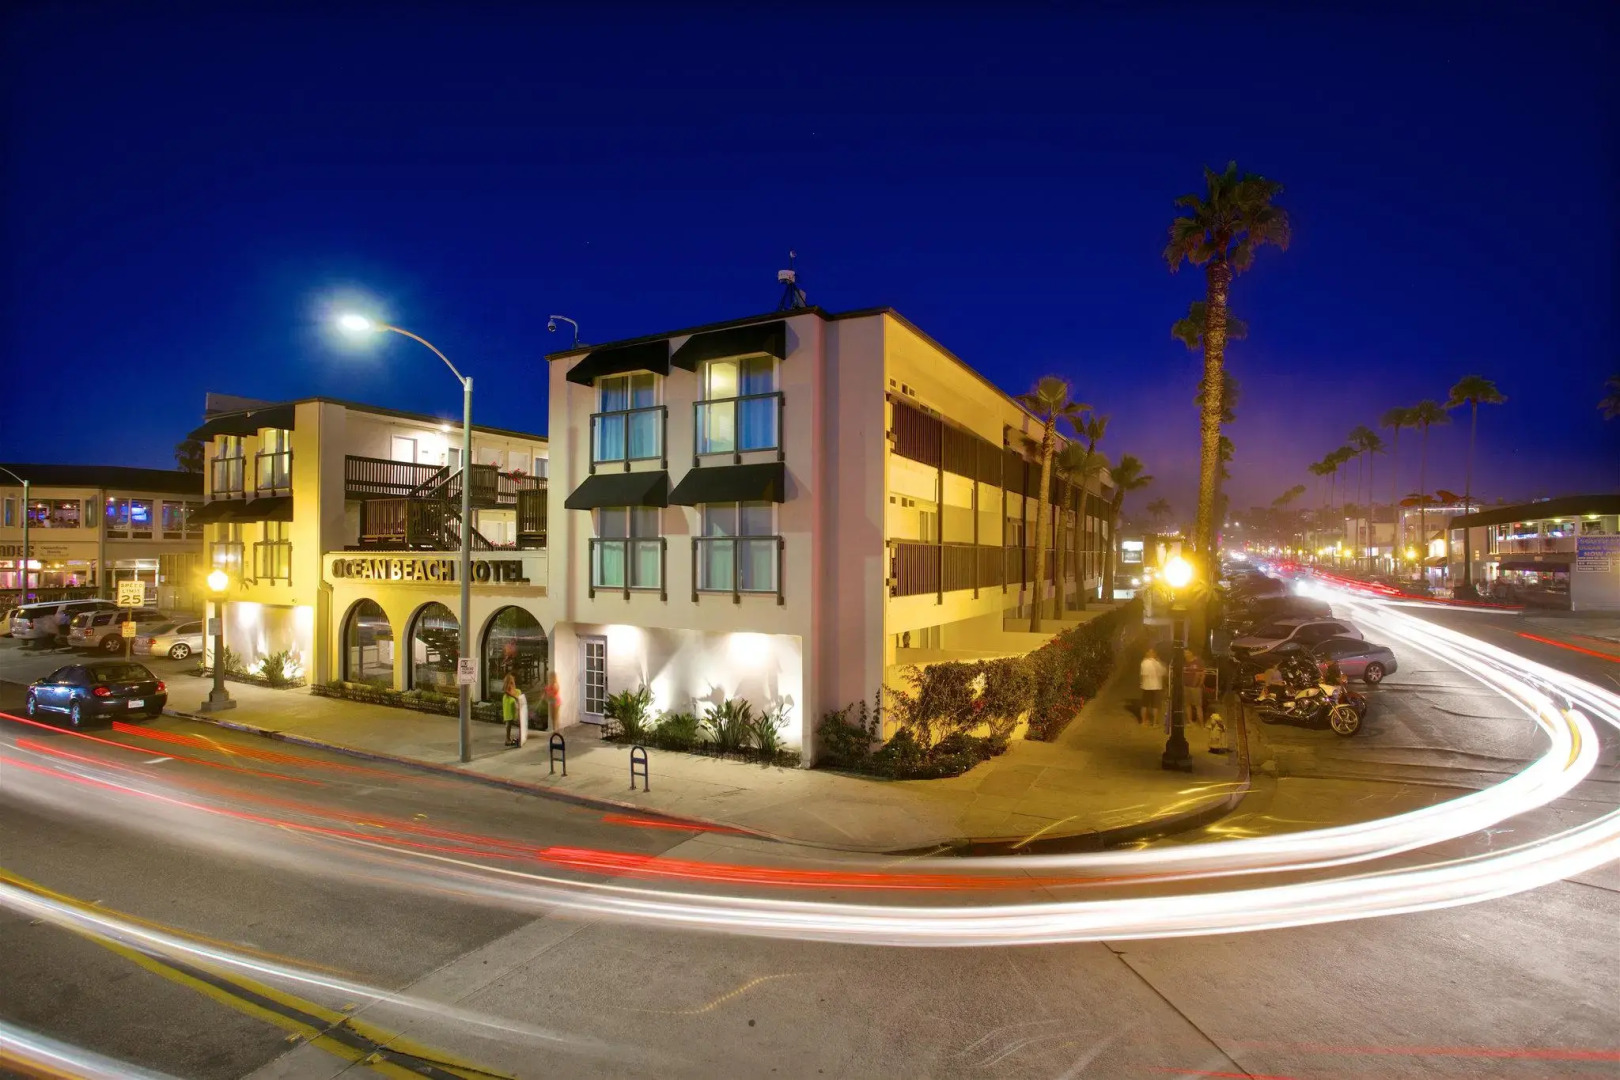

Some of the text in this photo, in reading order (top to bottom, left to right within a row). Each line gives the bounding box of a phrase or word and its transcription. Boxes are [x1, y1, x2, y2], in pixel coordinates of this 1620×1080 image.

[332, 558, 530, 582] OCEAN BEACH OTEL
[120, 595, 141, 605] 25
